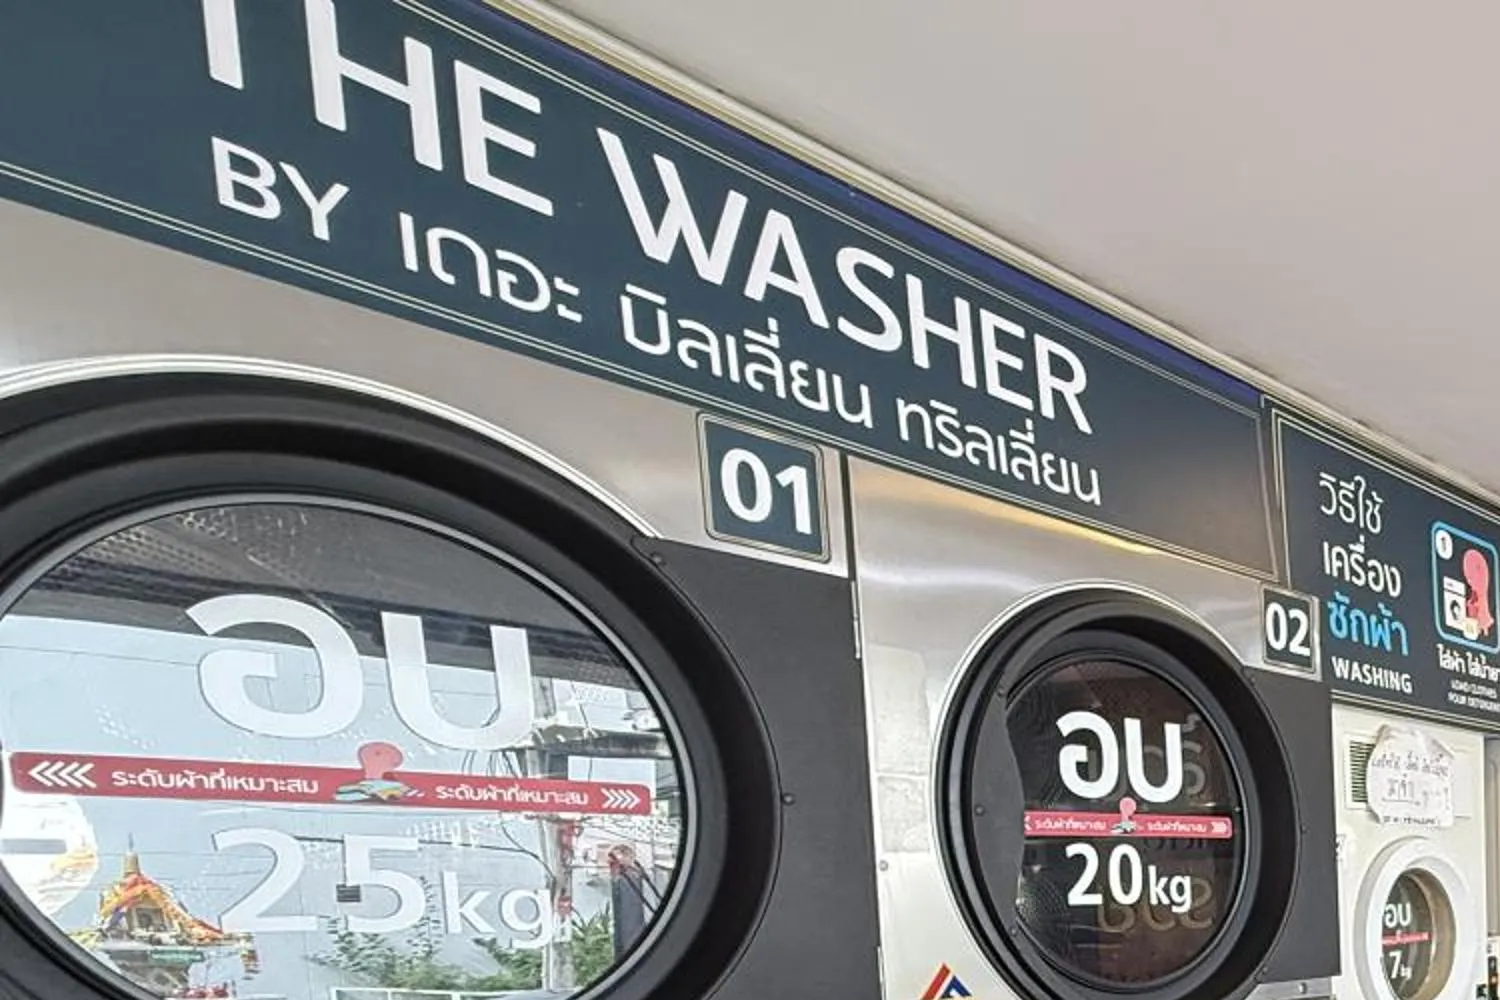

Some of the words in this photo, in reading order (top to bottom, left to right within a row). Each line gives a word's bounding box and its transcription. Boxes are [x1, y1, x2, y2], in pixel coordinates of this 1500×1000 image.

[597, 127, 1093, 434] WASHER
[211, 136, 349, 241] BY
[399, 211, 582, 323] เดอะ
[621, 284, 873, 428] บิลเลี่ยน
[896, 396, 1101, 505] ทริลเลี่ยน
[720, 447, 813, 536] 01
[1318, 471, 1384, 535] วิธีใช้
[1322, 535, 1402, 598] เครื่อง
[1264, 602, 1311, 658] 02
[1328, 592, 1410, 657] ซักผ้า
[186, 593, 537, 752] อบ
[1331, 656, 1413, 695] WASHING
[111, 766, 319, 797] ระดับผ้าที่เหมาะสม
[434, 781, 590, 807] ระดับผ้าที่เหมาะสม
[1056, 710, 1184, 803] อบ
[210, 827, 558, 949] 25kg
[1065, 843, 1193, 912] 20kg
[1383, 901, 1412, 928] อบ
